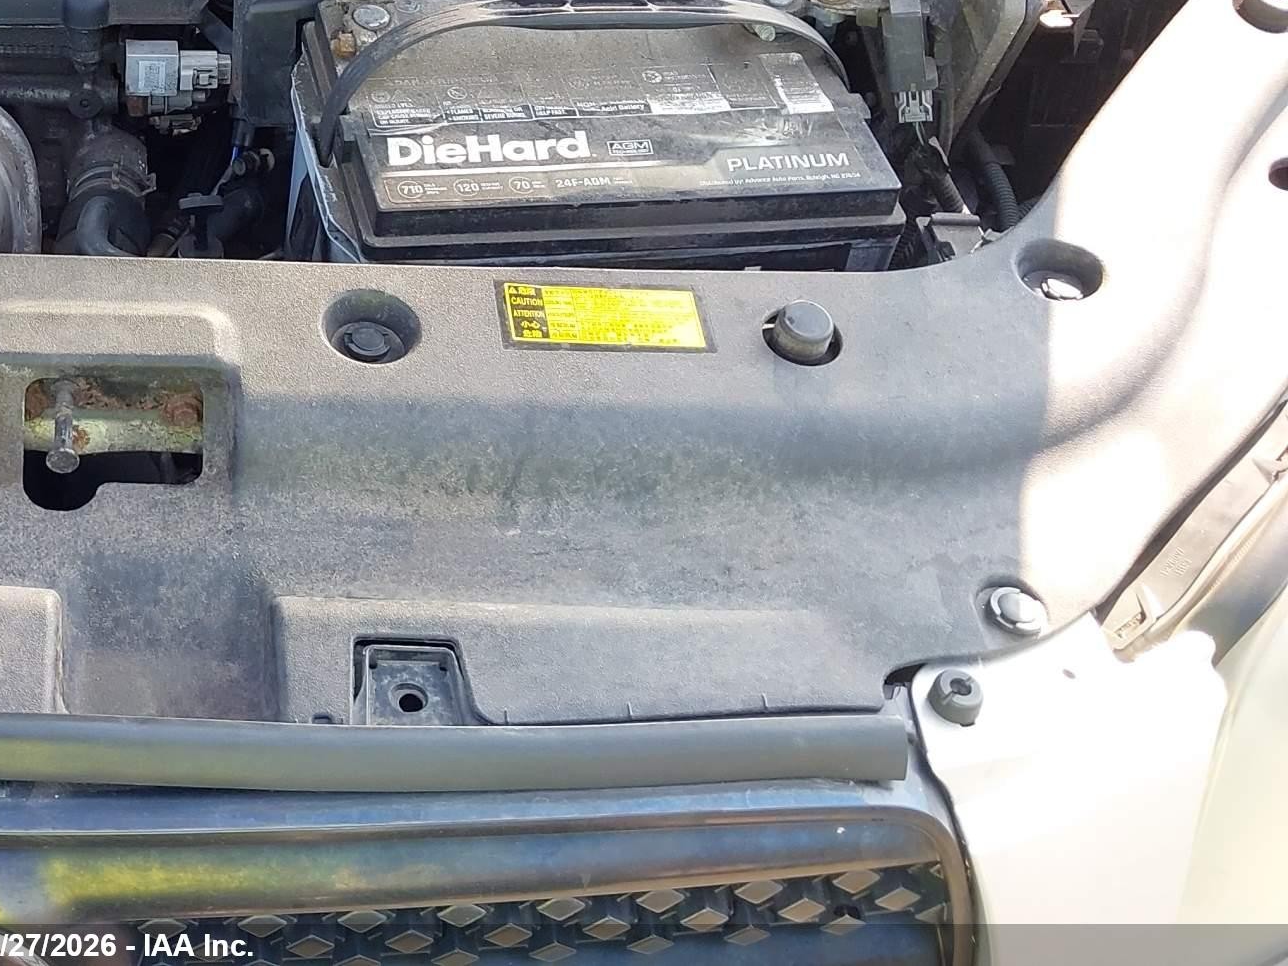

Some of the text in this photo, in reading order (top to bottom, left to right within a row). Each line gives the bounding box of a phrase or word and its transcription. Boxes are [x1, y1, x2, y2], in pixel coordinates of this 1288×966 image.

[612, 141, 649, 151] AGM
[727, 152, 850, 172] PLATINUM
[401, 185, 424, 195] 710
[457, 183, 480, 193] 120
[513, 180, 531, 190] 70
[511, 296, 543, 306] CAUTION
[513, 309, 545, 318] ATTENTION
